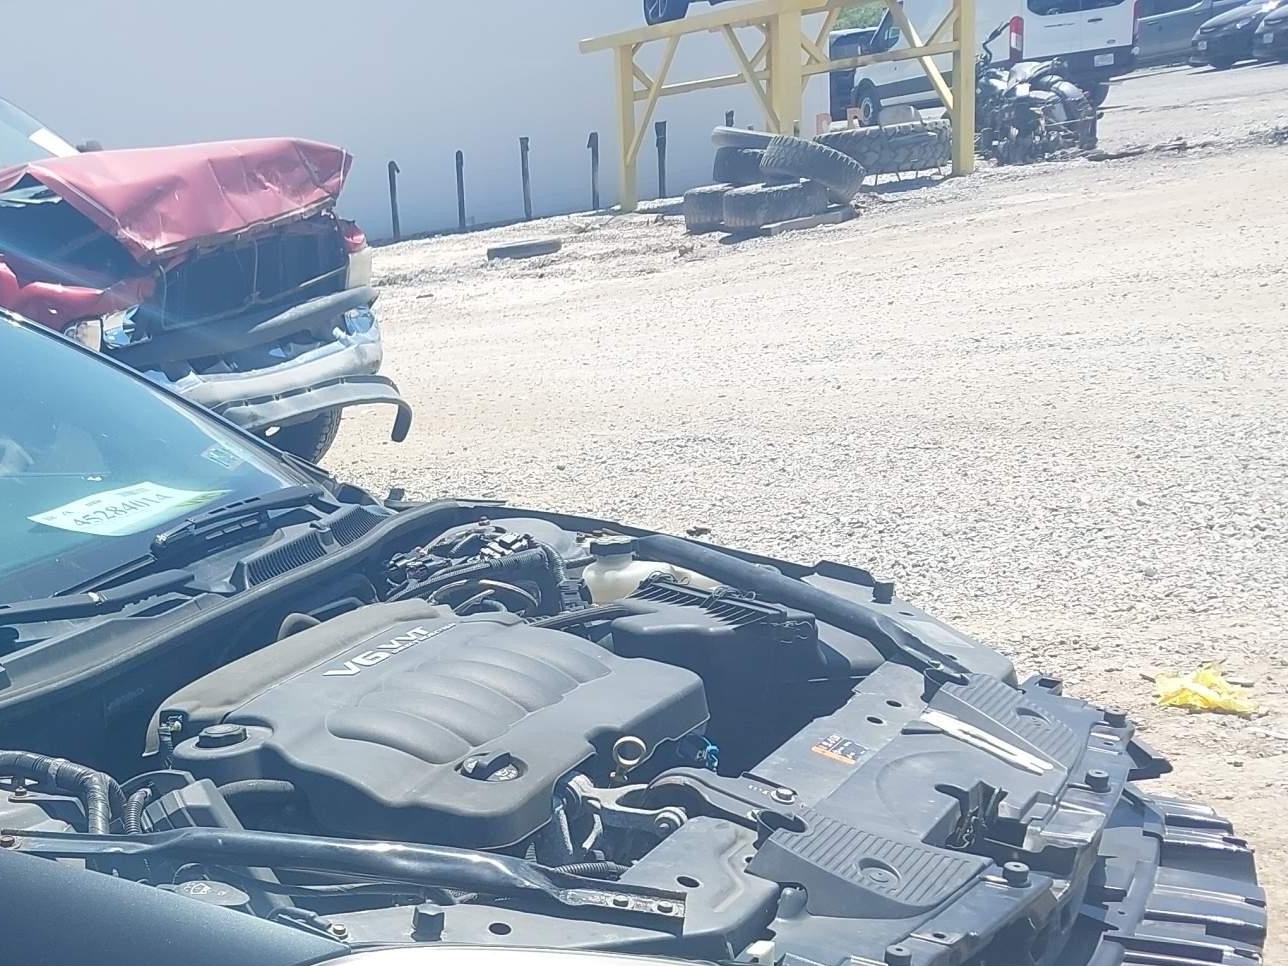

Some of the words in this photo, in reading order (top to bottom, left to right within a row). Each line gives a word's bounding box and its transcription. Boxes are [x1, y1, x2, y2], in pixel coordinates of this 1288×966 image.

[73, 493, 174, 528] 45284014
[321, 650, 392, 677] V6
[376, 625, 431, 650] VVT
